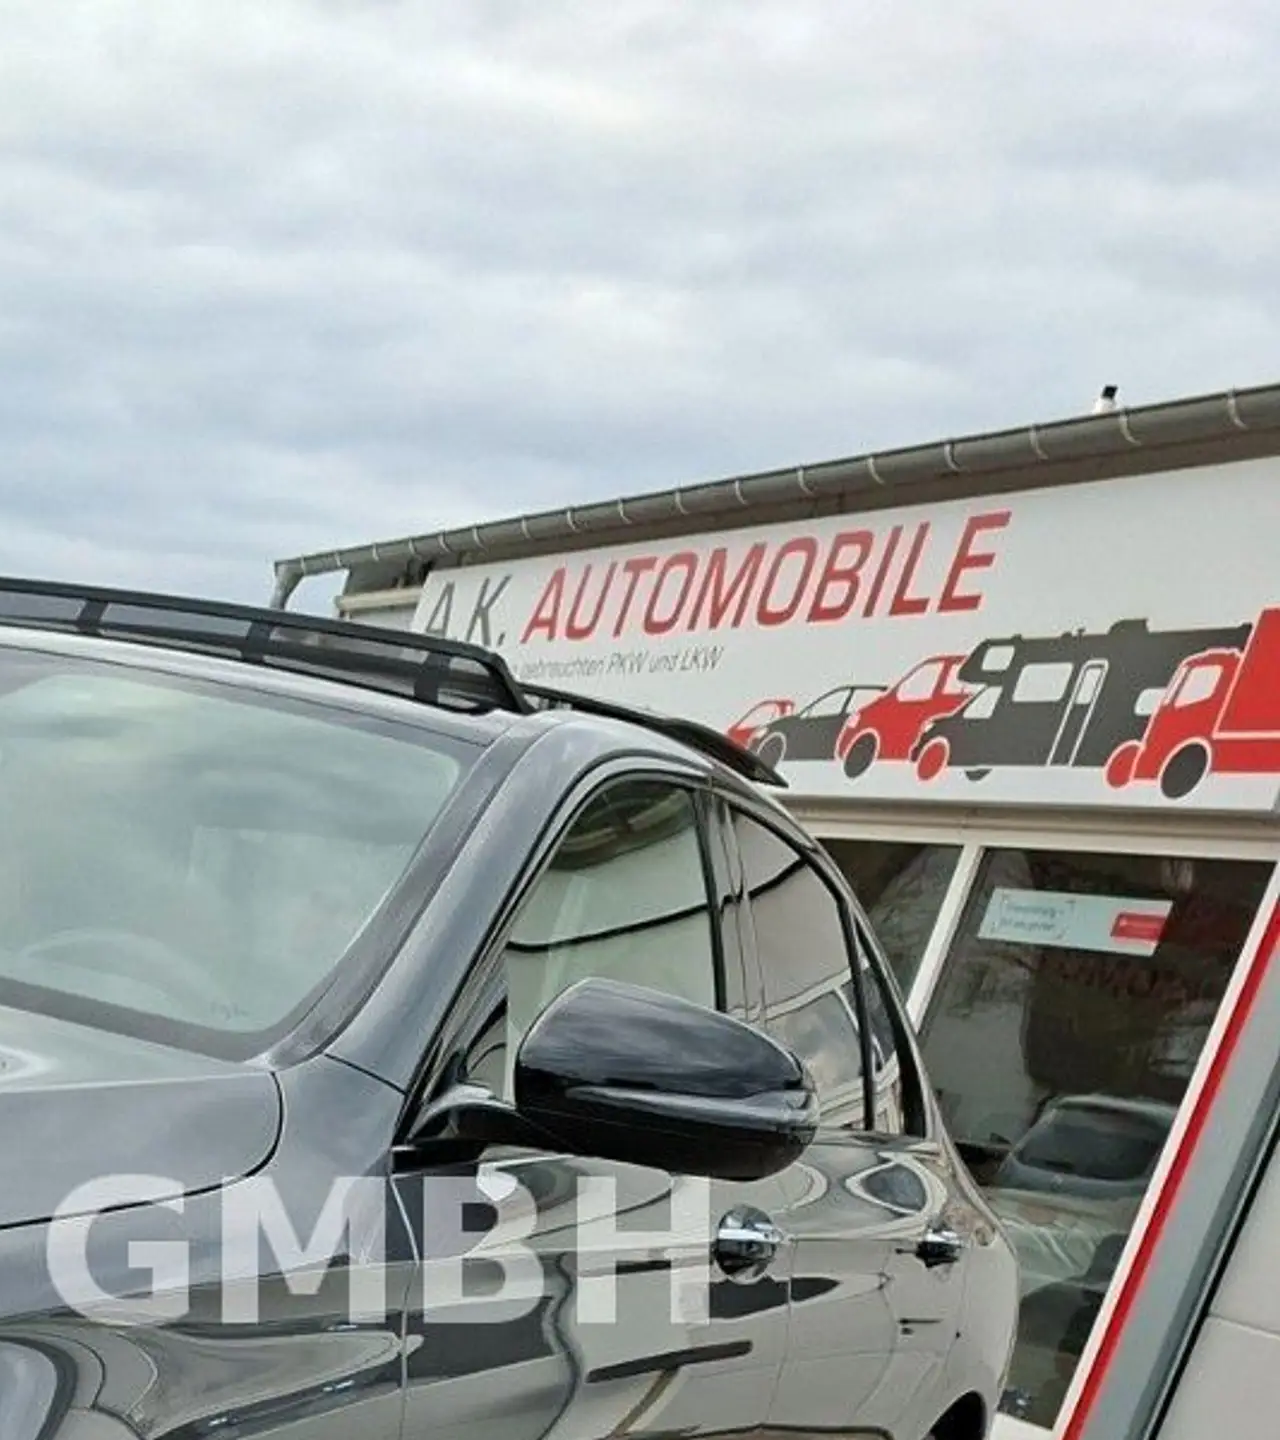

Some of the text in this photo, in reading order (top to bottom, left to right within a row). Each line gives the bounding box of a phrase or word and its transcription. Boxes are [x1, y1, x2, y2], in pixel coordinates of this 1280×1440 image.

[426, 511, 1012, 647] AK. AUTOMOBILE
[604, 649, 649, 675] PKW
[648, 654, 679, 673] und
[679, 644, 725, 672] LKW
